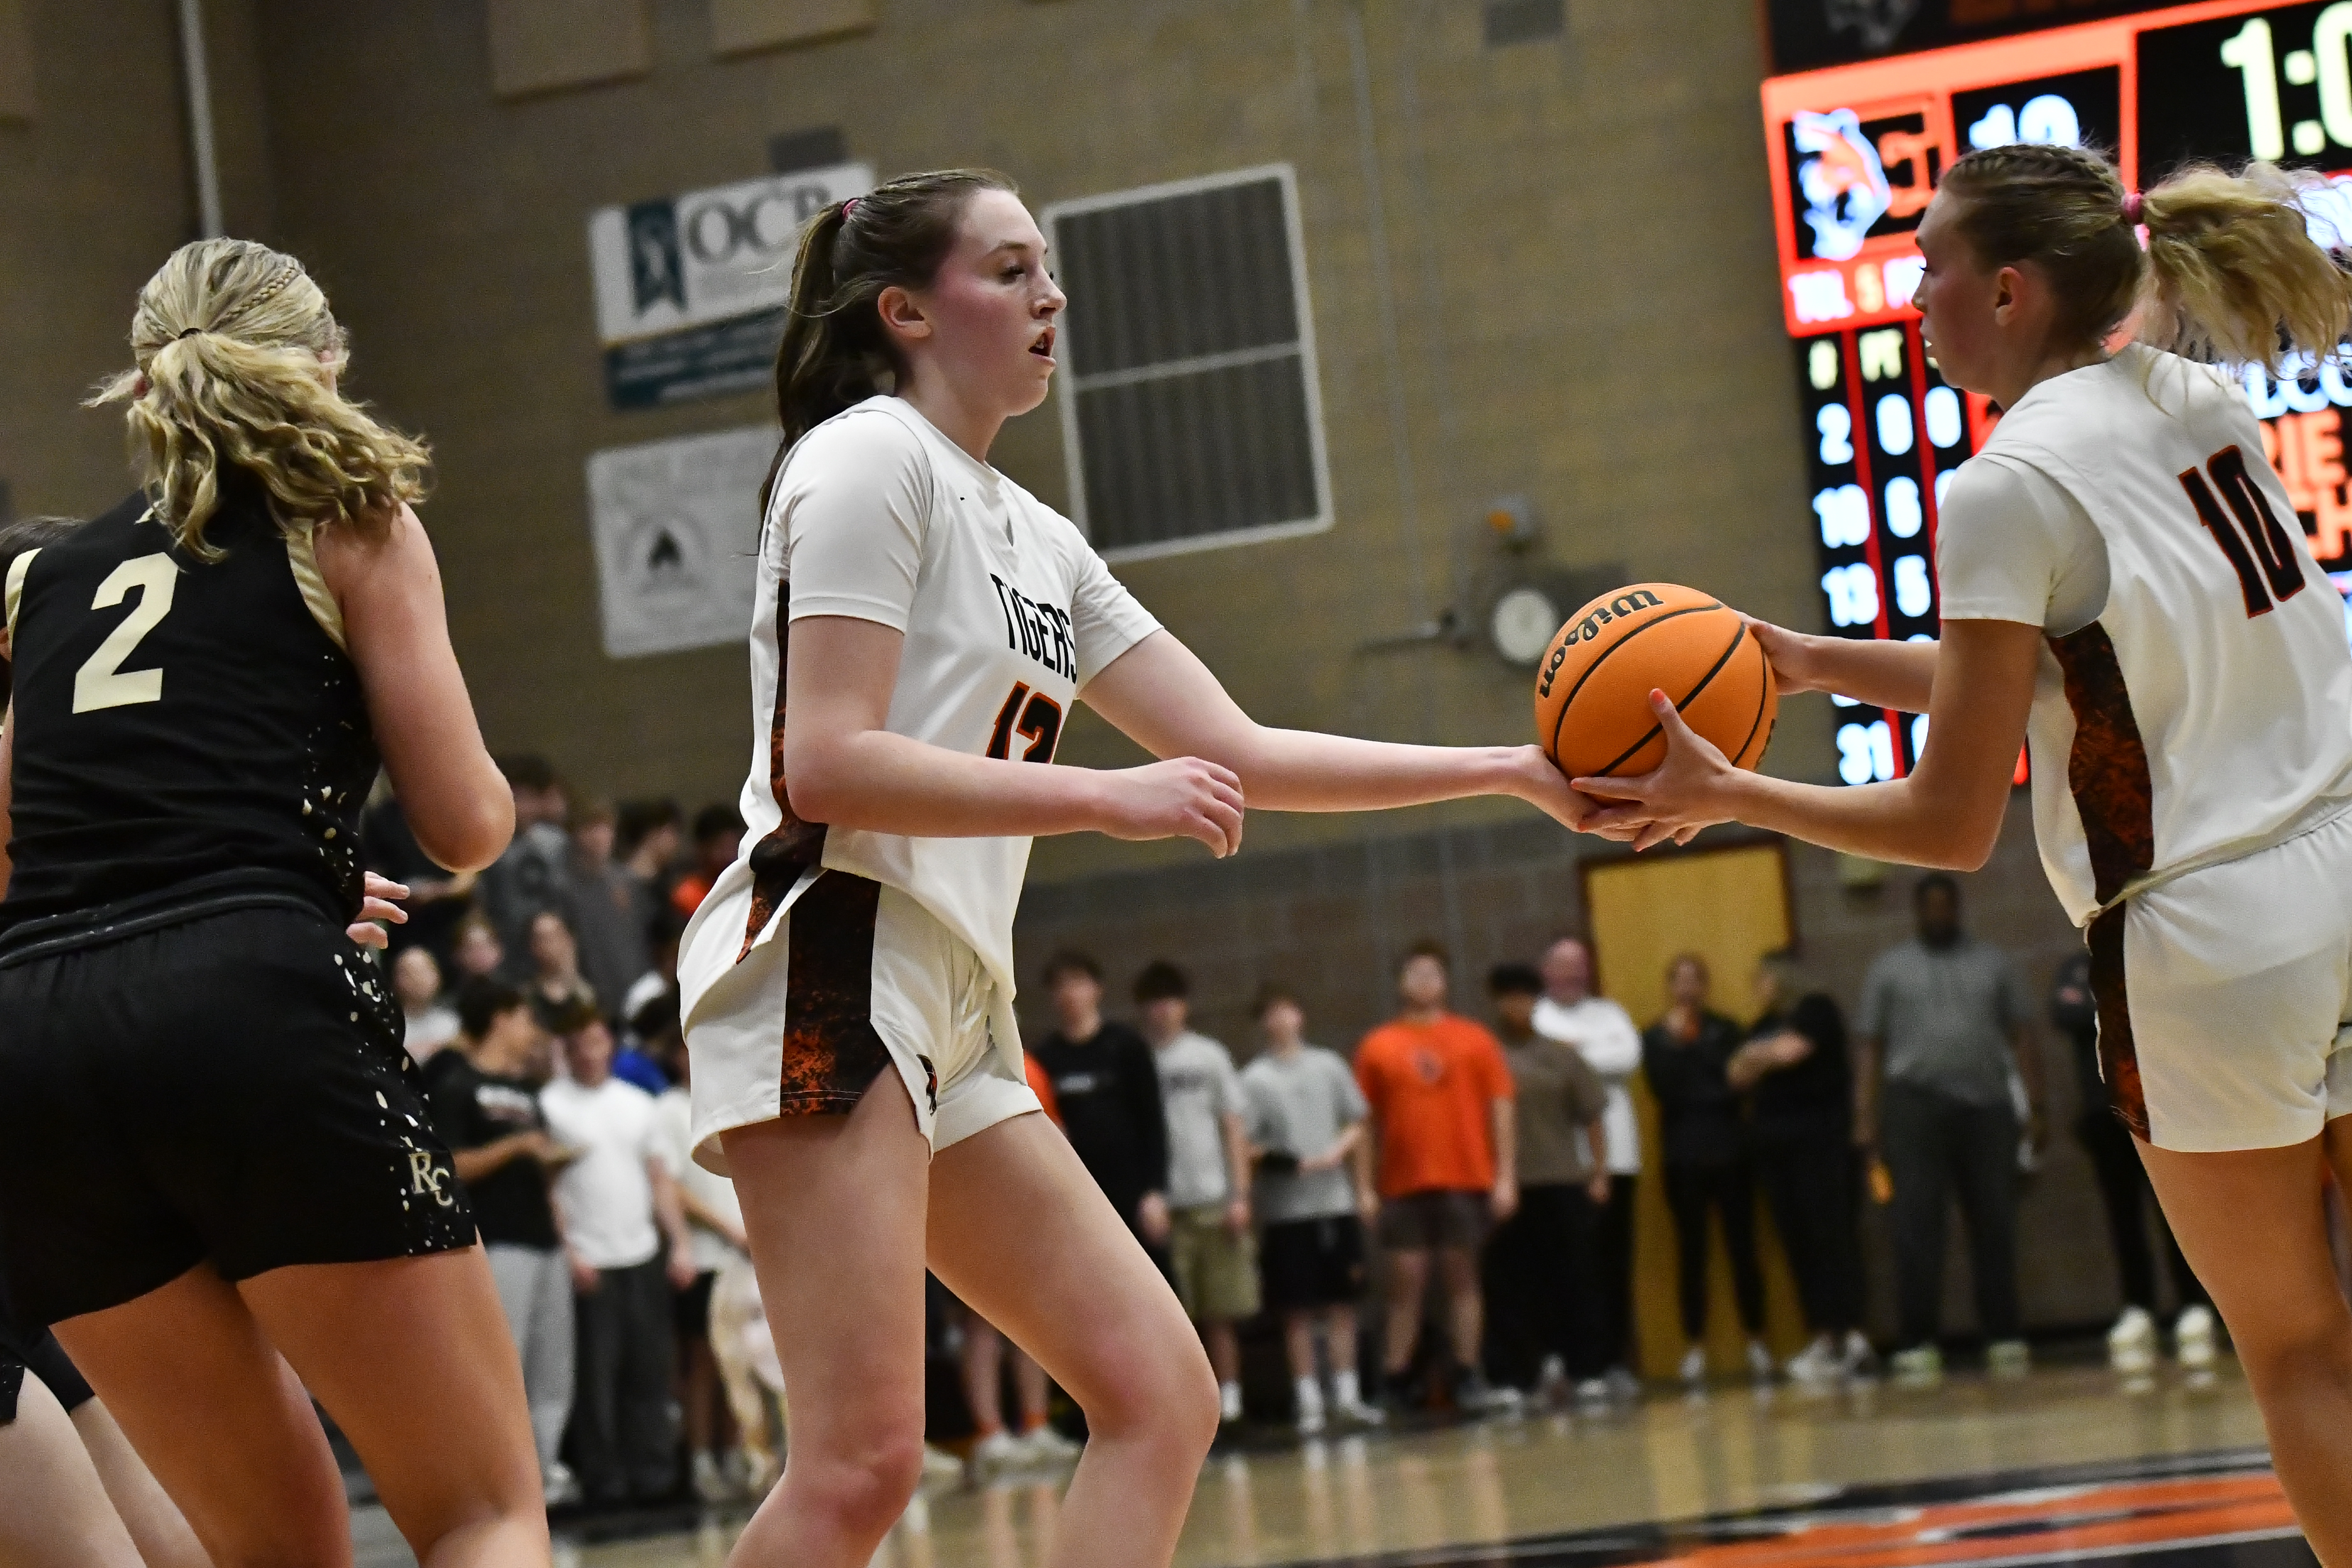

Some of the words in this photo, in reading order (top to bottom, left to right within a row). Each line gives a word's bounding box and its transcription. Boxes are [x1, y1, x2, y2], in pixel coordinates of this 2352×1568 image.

[1816, 403, 1854, 465] 2
[2178, 444, 2306, 619] 10
[72, 552, 178, 714] 2
[990, 573, 1077, 685] TIGERS
[1540, 590, 1664, 698] Wilson
[1836, 720, 1895, 786] 31
[408, 1152, 453, 1206] RC
